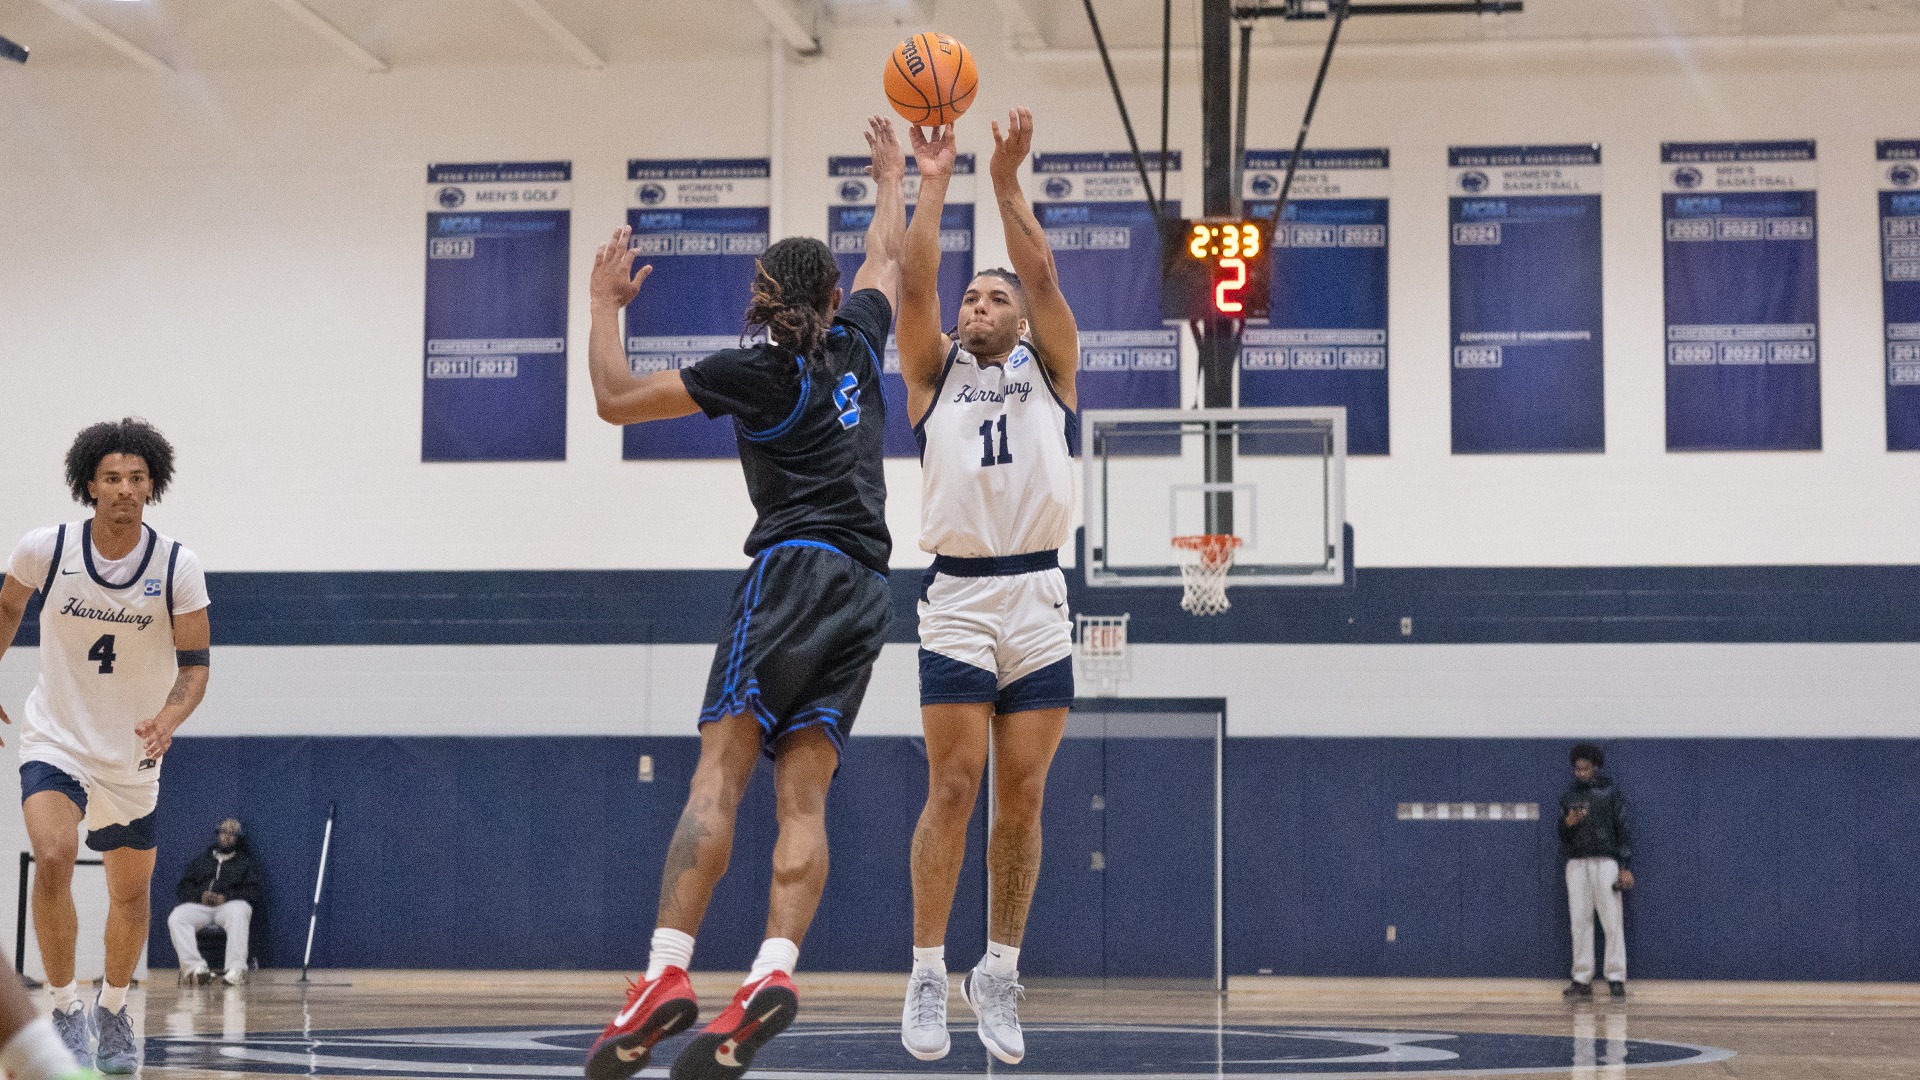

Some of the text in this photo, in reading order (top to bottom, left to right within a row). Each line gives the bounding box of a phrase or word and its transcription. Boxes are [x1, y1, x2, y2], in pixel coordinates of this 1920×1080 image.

[476, 189, 559, 202] MEN'S GOLF
[436, 240, 470, 256] 2012
[1191, 225, 1259, 258] 2:33
[1216, 259, 1245, 312] 2
[434, 360, 513, 374] 2011 2012
[979, 414, 1013, 467] 11
[60, 597, 153, 630] Harrisburg
[88, 633, 116, 674] 4
